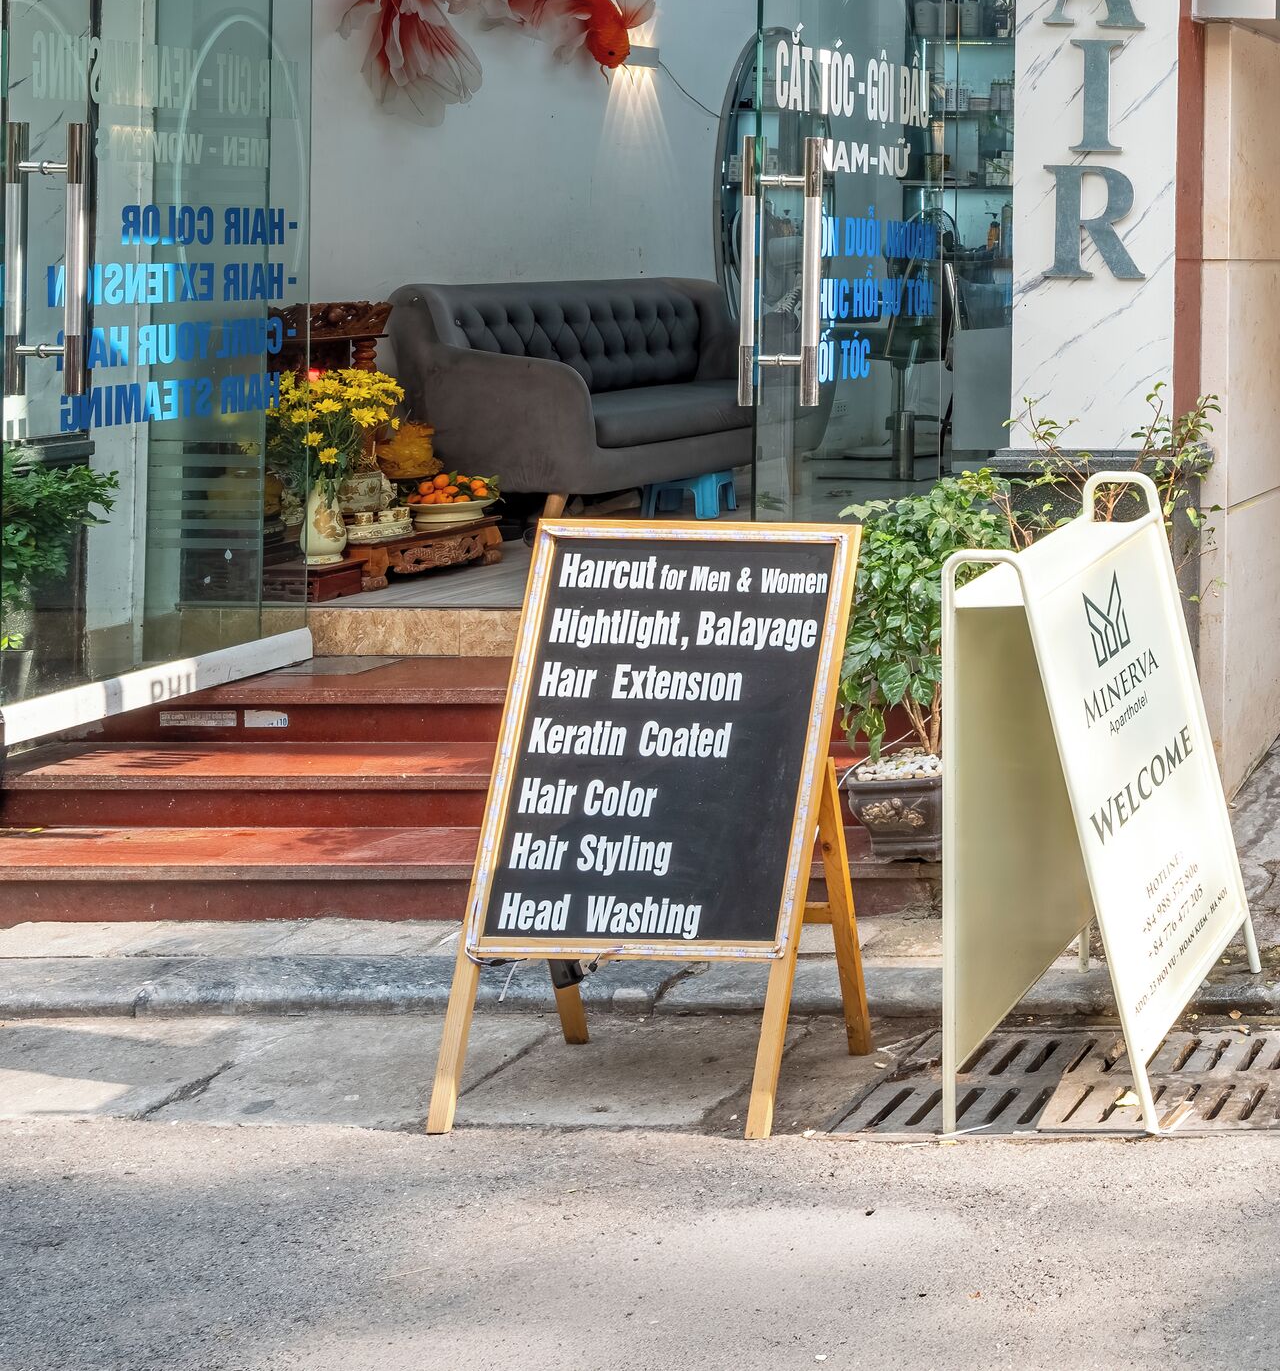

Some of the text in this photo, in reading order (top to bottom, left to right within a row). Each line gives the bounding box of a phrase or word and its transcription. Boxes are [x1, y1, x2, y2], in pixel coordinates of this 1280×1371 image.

[775, 22, 813, 112] CẮT
[820, 38, 855, 117] TÓC
[841, 330, 871, 380] TÓC
[558, 553, 828, 594] Haircut for Men & Women
[695, 610, 819, 652] Balayage
[538, 661, 743, 702] Hair Extension
[1083, 647, 1160, 730] MINERVA
[1108, 689, 1149, 737] Aparthotel
[527, 717, 733, 758] Keratin Coated
[517, 777, 658, 818] Hair Color
[1089, 724, 1194, 846] WELCOME
[508, 832, 673, 876] Hair Styling
[497, 892, 702, 940] Head Washing
